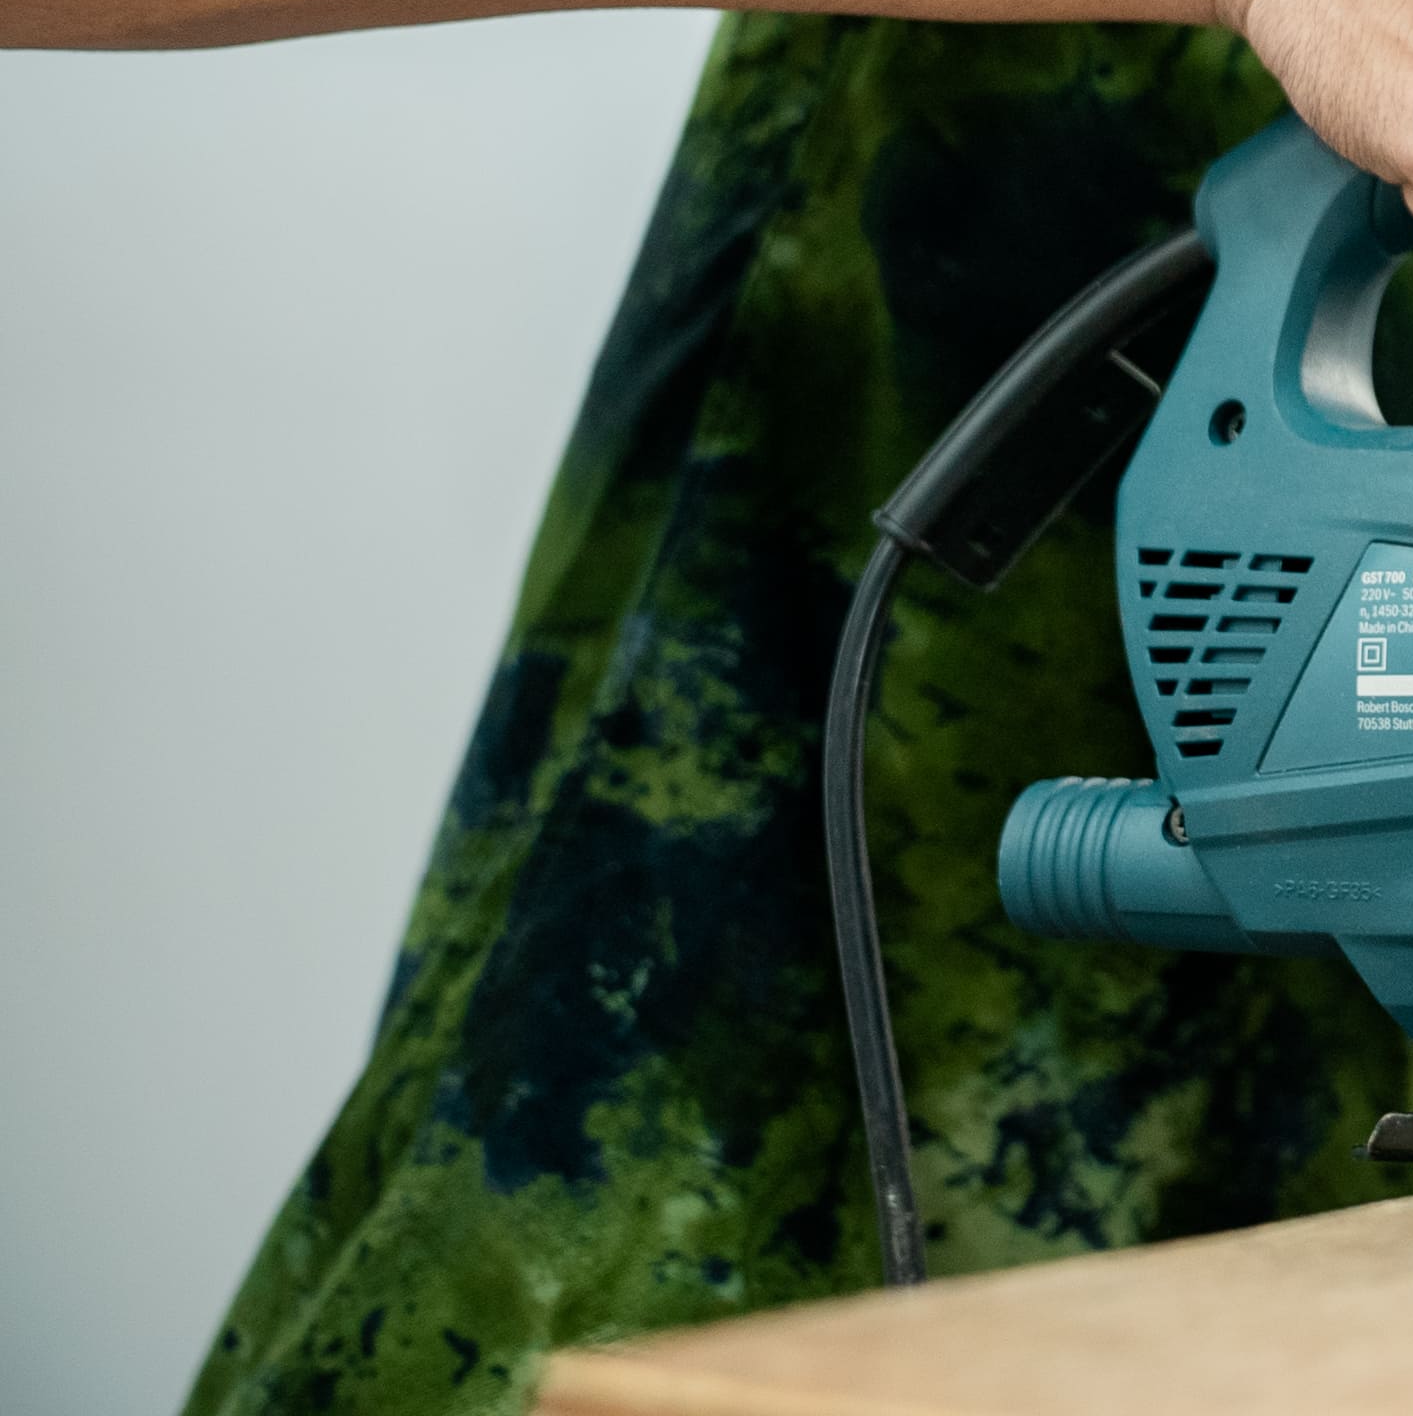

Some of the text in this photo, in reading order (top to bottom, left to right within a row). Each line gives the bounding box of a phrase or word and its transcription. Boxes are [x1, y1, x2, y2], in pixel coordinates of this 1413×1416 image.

[1361, 571, 1384, 584] GST
[1384, 570, 1406, 584] 700
[1361, 588, 1382, 601] 220
[1359, 621, 1385, 634] Made
[1386, 621, 1396, 634] in
[1357, 700, 1390, 713] Robert
[1358, 717, 1391, 730] 70538
